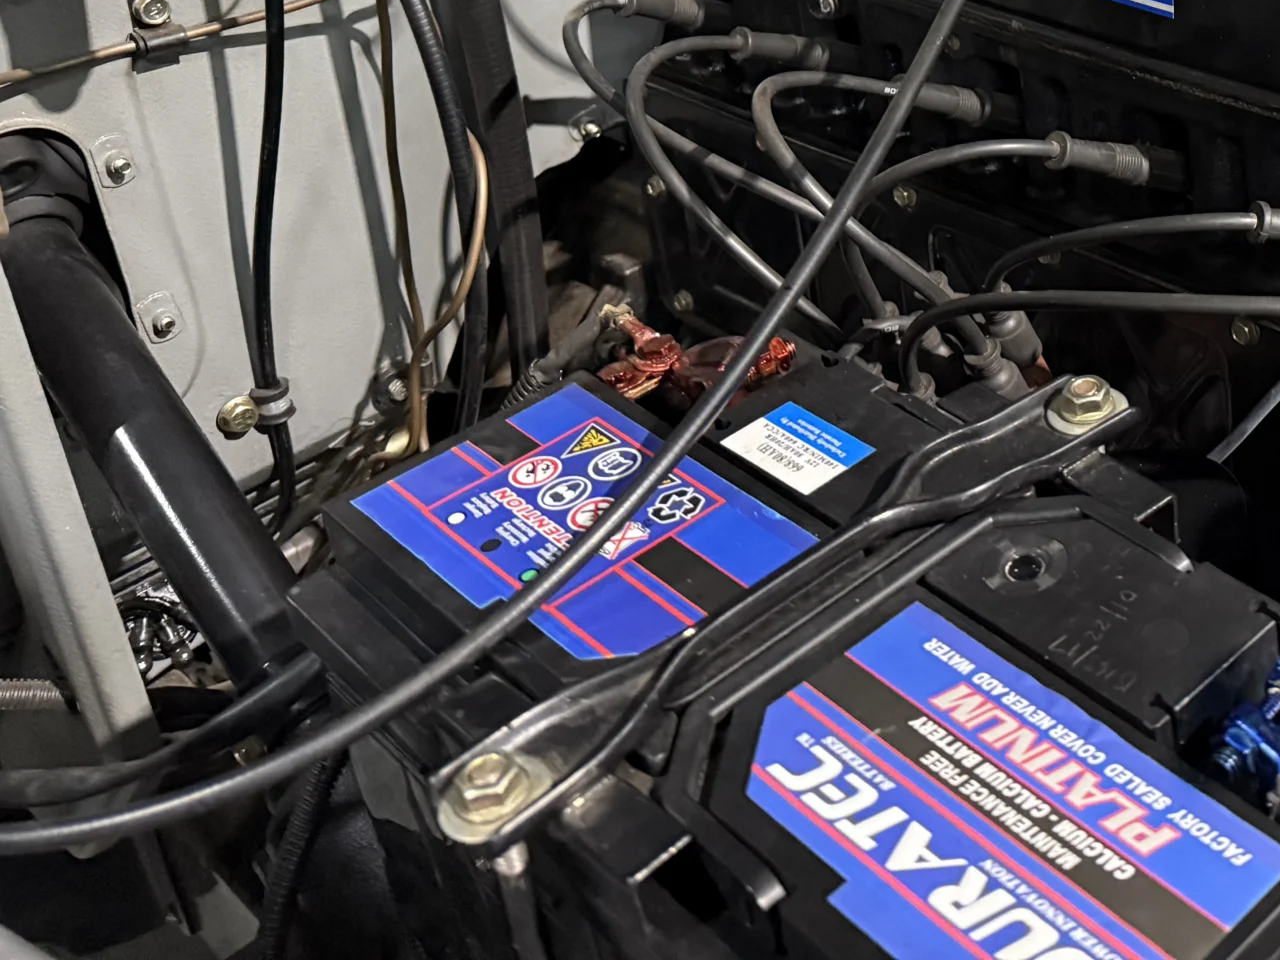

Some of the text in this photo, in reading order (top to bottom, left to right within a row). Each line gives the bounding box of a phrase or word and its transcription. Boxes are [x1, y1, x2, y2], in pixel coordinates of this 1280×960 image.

[490, 487, 573, 551] TENTION
[820, 735, 897, 791] BATTERIES
[907, 716, 983, 768] BATTERY
[923, 638, 1253, 866] FACTORY SEALED COVER NEVER ADD WATER
[928, 681, 1183, 858] PLATINUM
[919, 750, 1082, 871] MAINTENANCE FREE
[973, 762, 1052, 818] CALCIUM
[765, 745, 1096, 960] URATEC
[1051, 819, 1136, 880] CALCIUM
[978, 859, 1078, 932] INNOVATION
